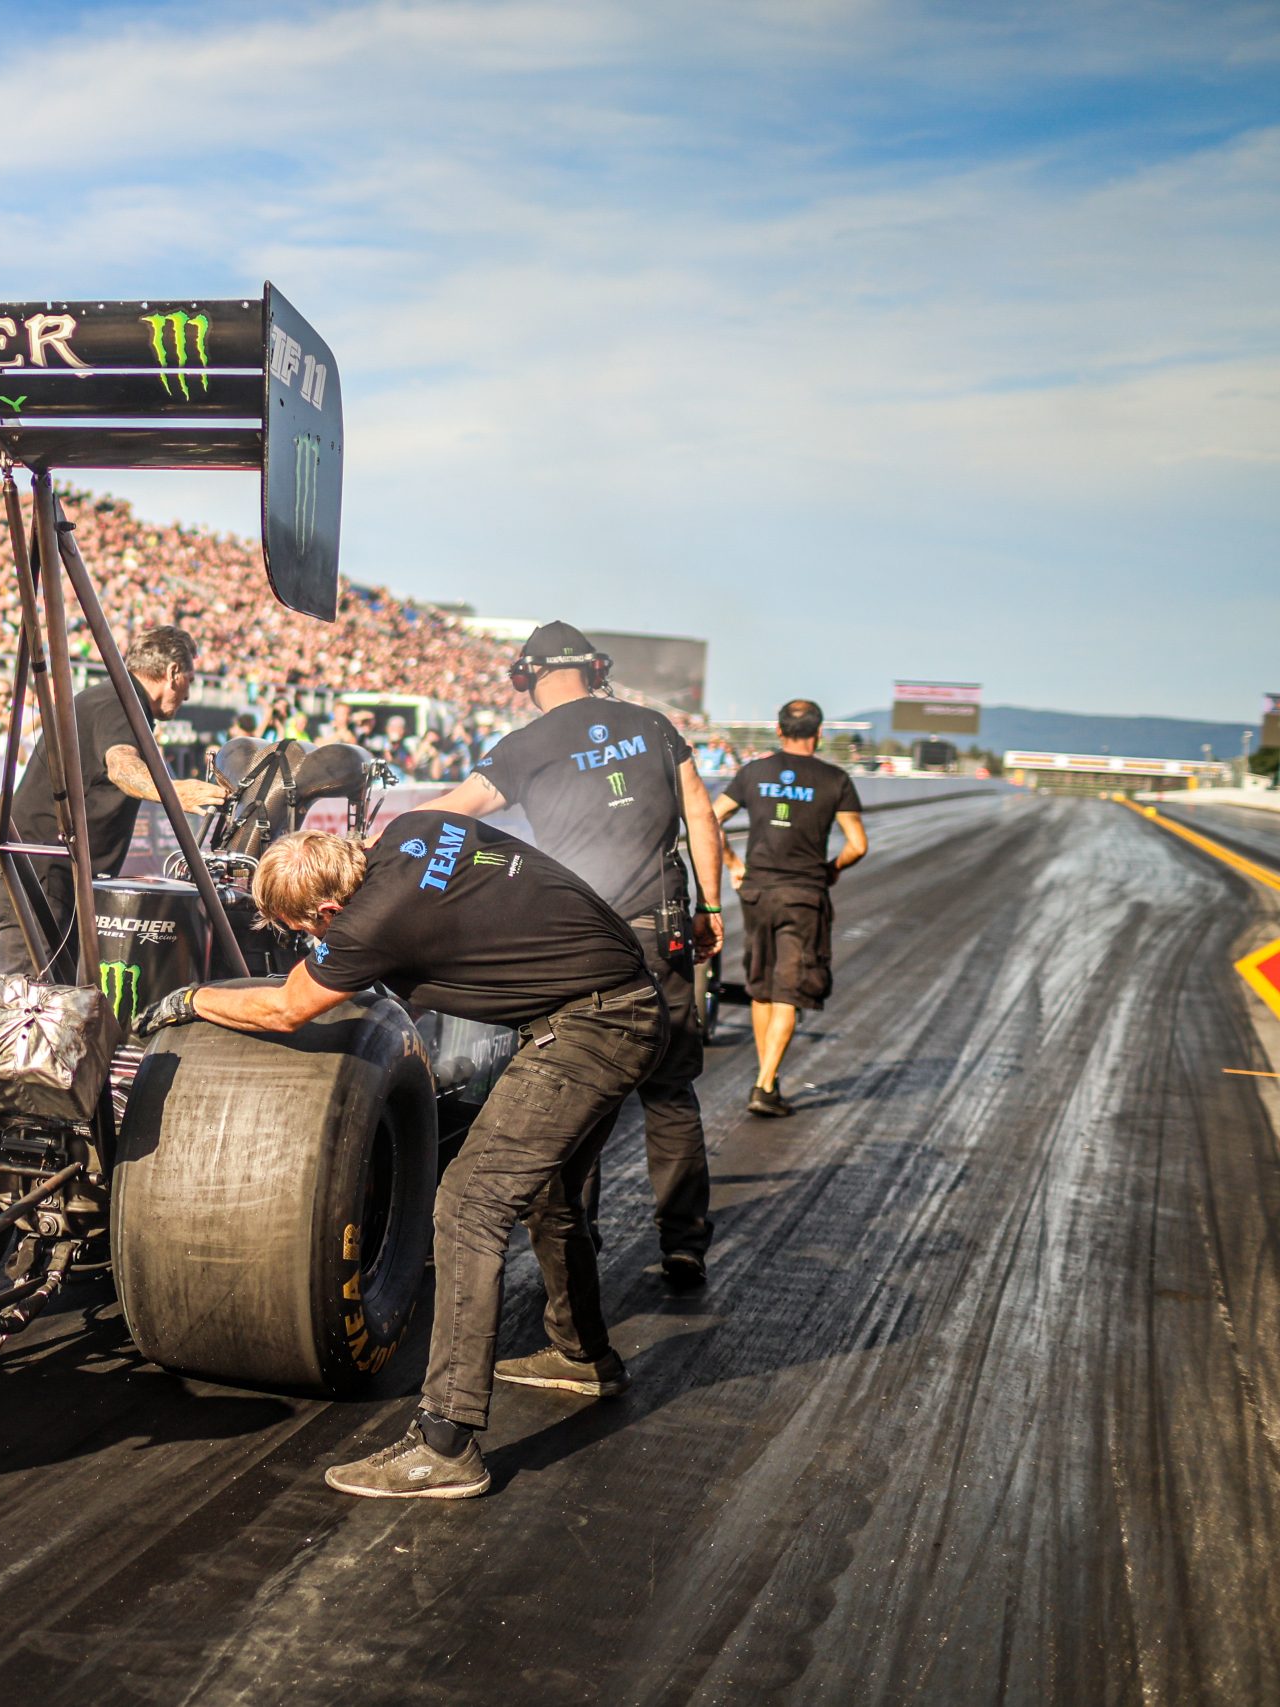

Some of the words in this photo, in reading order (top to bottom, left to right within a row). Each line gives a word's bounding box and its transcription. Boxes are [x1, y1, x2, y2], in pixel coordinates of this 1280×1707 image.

[300, 353, 327, 411] 11
[570, 735, 647, 771] TEAM
[757, 782, 815, 802] TEAM
[419, 822, 467, 891] TEAM
[95, 915, 177, 934] BACHER
[97, 930, 127, 939] FUEL
[136, 932, 178, 945] Racing
